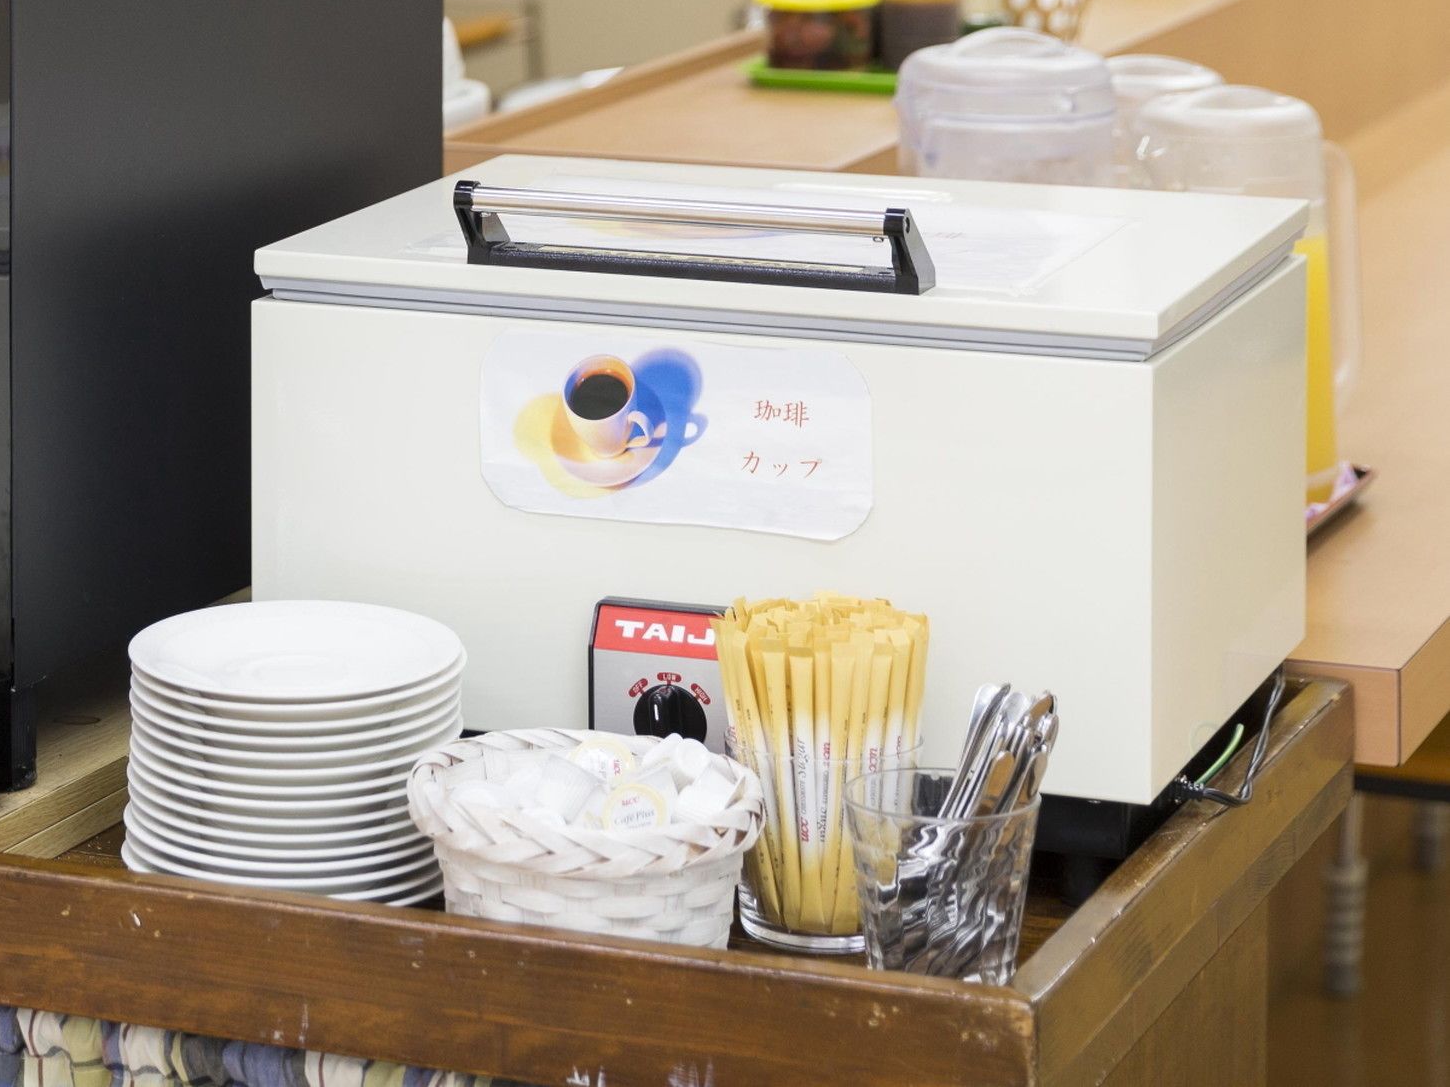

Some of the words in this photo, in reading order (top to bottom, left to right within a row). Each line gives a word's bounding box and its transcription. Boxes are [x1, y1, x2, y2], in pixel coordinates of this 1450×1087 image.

[754, 399, 810, 428] 珈琲
[740, 451, 823, 479] カップ
[615, 619, 716, 646] TAIJ
[662, 673, 677, 682] LOW
[694, 686, 708, 702] HIGH
